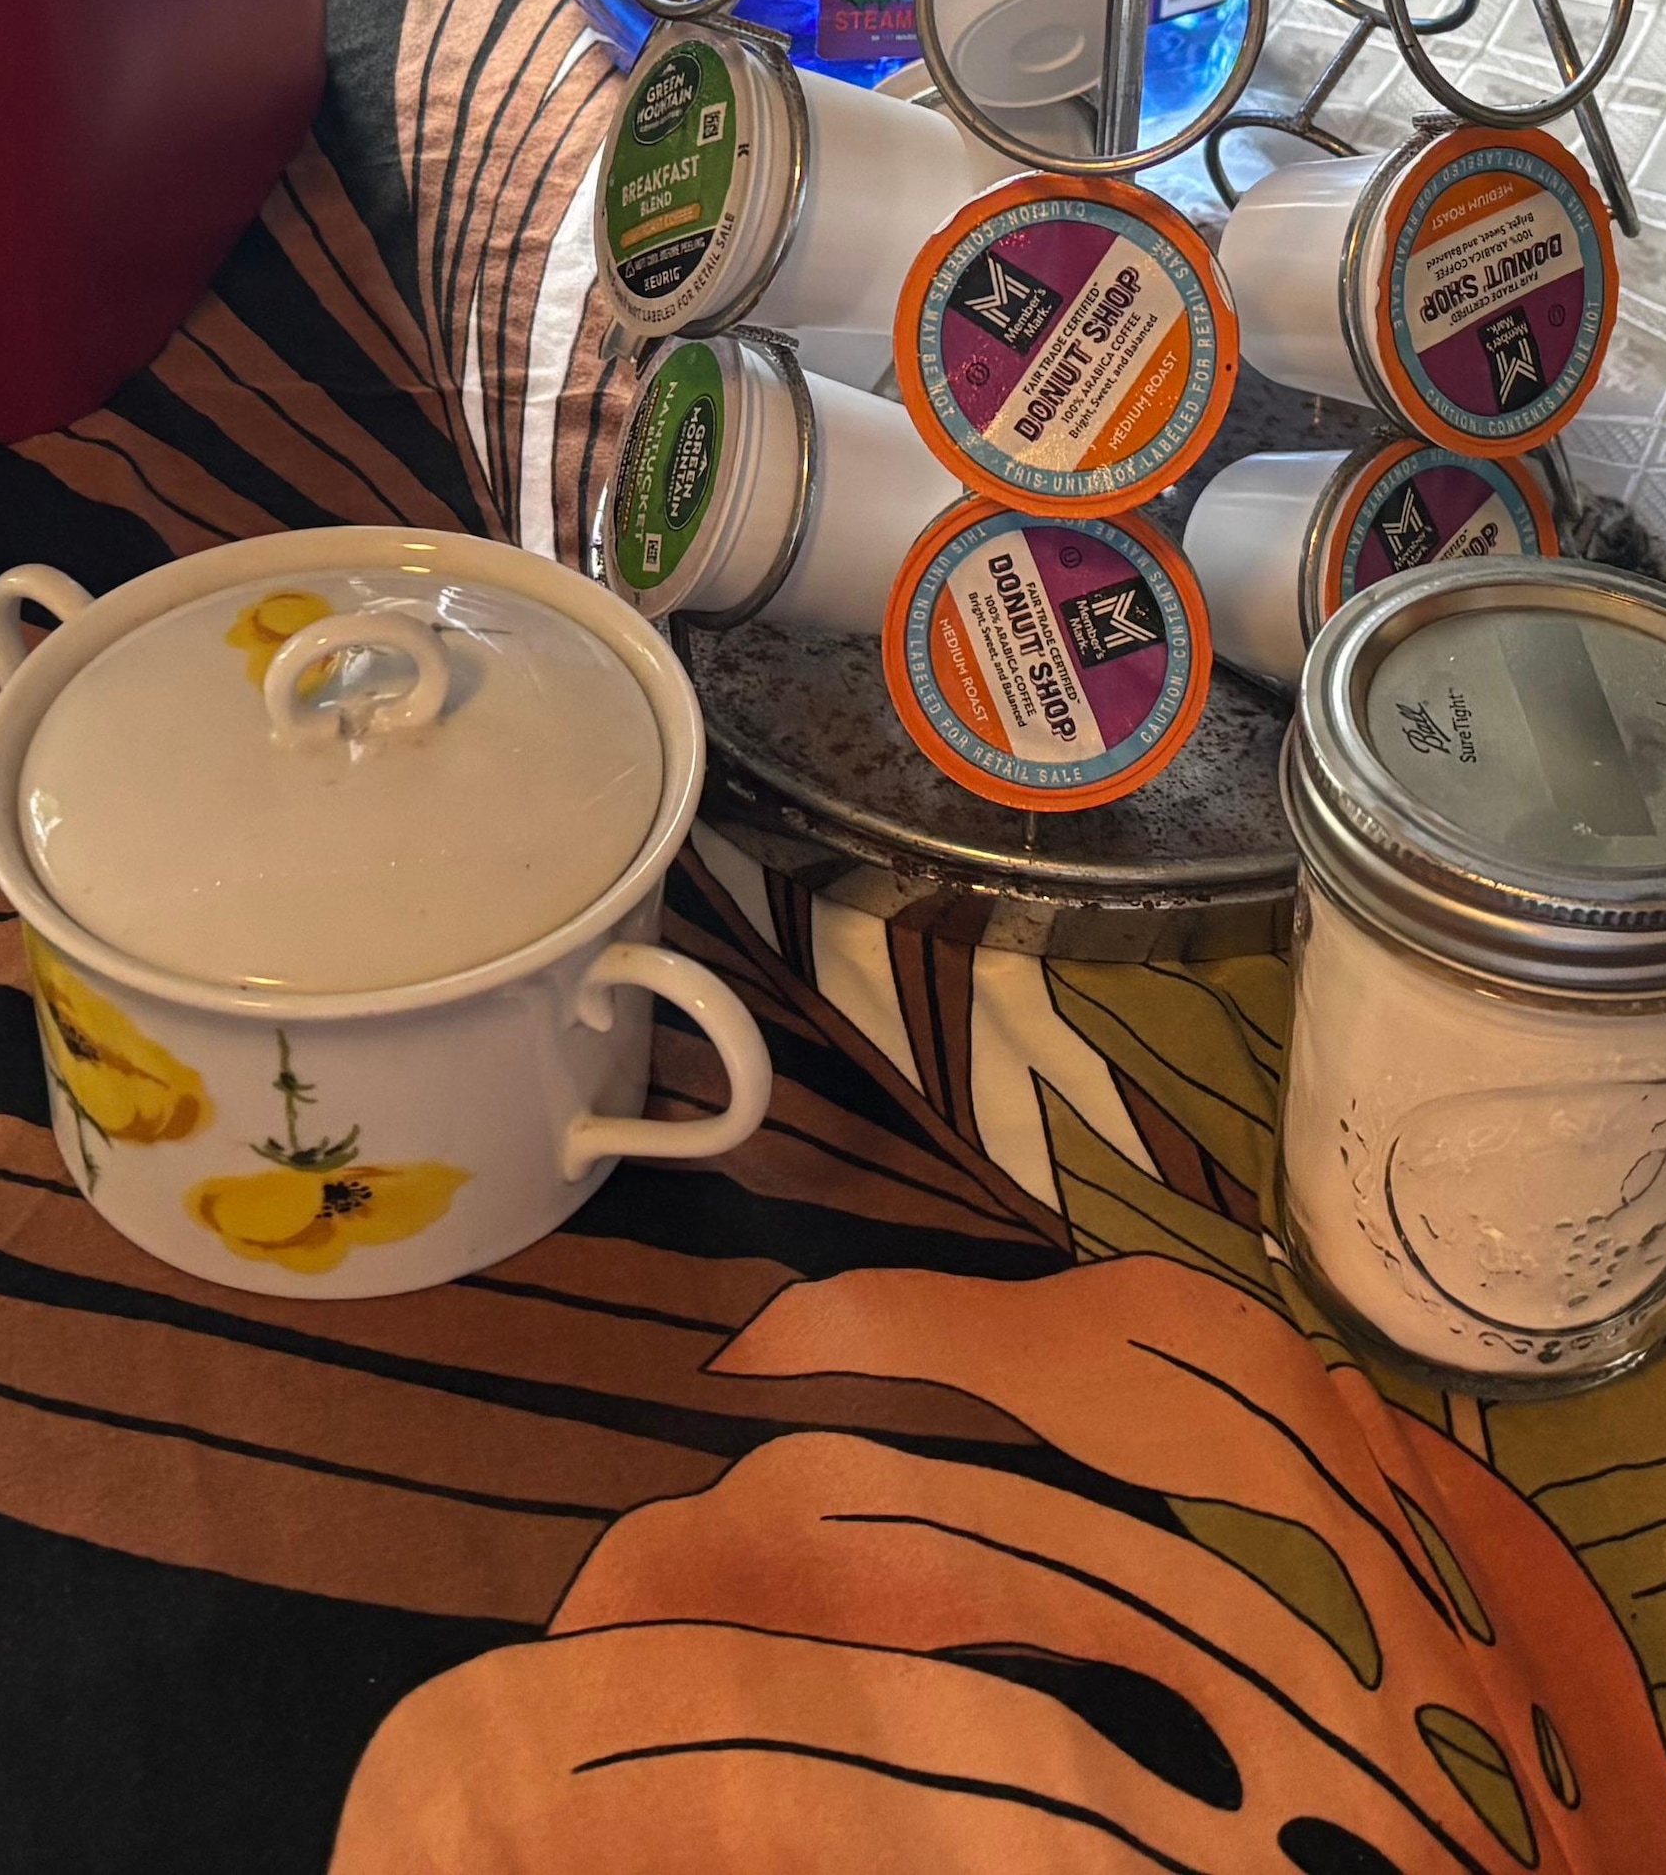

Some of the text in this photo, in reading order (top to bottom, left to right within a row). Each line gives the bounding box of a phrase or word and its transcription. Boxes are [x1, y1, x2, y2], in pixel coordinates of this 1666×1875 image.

[646, 73, 686, 103] GREEN
[621, 154, 702, 207] BREAKFAST
[640, 191, 672, 217] BLEND
[1428, 179, 1515, 231] MEDIUM ROAST
[677, 289, 695, 311] FOR
[693, 252, 721, 292] RETAIL
[717, 212, 735, 250] SALE
[1424, 245, 1463, 271] Balanced
[1433, 227, 1533, 281] 100% ARABICA COFFEE
[1460, 237, 1480, 253] and
[643, 266, 682, 292] KEURIG
[1413, 231, 1568, 324] DONUT SHOP
[1489, 281, 1520, 302] TRADE
[1517, 270, 1540, 288] FAIR
[921, 309, 939, 343] MAY
[1002, 284, 1048, 344] Member's
[1110, 355, 1130, 377] and
[1122, 311, 1159, 358] Balanced
[1183, 282, 1211, 346] RETAIL
[1482, 321, 1530, 352] Member's
[922, 353, 939, 376] BE
[1012, 335, 1095, 444] DONUT
[1079, 262, 1148, 347] SHOP
[1021, 368, 1045, 396] FAIR
[1038, 334, 1068, 372] TRADE
[1060, 310, 1141, 425] 100% ARABICA COFFEE
[1191, 357, 1211, 393] FOR
[1488, 393, 1556, 433] CONTENTS
[1555, 363, 1581, 400] MAY
[1584, 300, 1600, 334] HOT
[929, 382, 955, 419] HOT
[1106, 349, 1180, 452] MEDIUM ROAST
[630, 379, 678, 544] NANTUCKET
[635, 425, 654, 486] BLEND
[669, 405, 700, 518] MOUNTAIN
[681, 423, 706, 498] GREEN
[1140, 399, 1200, 469] LABELED
[1000, 461, 1043, 488] THIS
[1094, 522, 1116, 541] BE
[1119, 537, 1151, 567] MAY
[1024, 581, 1042, 608] FAIR
[1034, 607, 1057, 646] TRADE
[1075, 598, 1106, 660] Member's
[1147, 569, 1186, 659] CONTENTS
[910, 524, 1082, 783] THIS UNIT NOT LABELED FOR RETAIL SALE
[938, 617, 988, 724] MEDIUM ROAST
[982, 593, 1037, 718] 100% ARABICA COFFEE
[986, 552, 1078, 746] DONUT SHOP
[992, 660, 1008, 682] and
[1001, 680, 1028, 728] Balanced
[1397, 701, 1452, 755] Ball
[1451, 689, 1477, 763] SureTight
